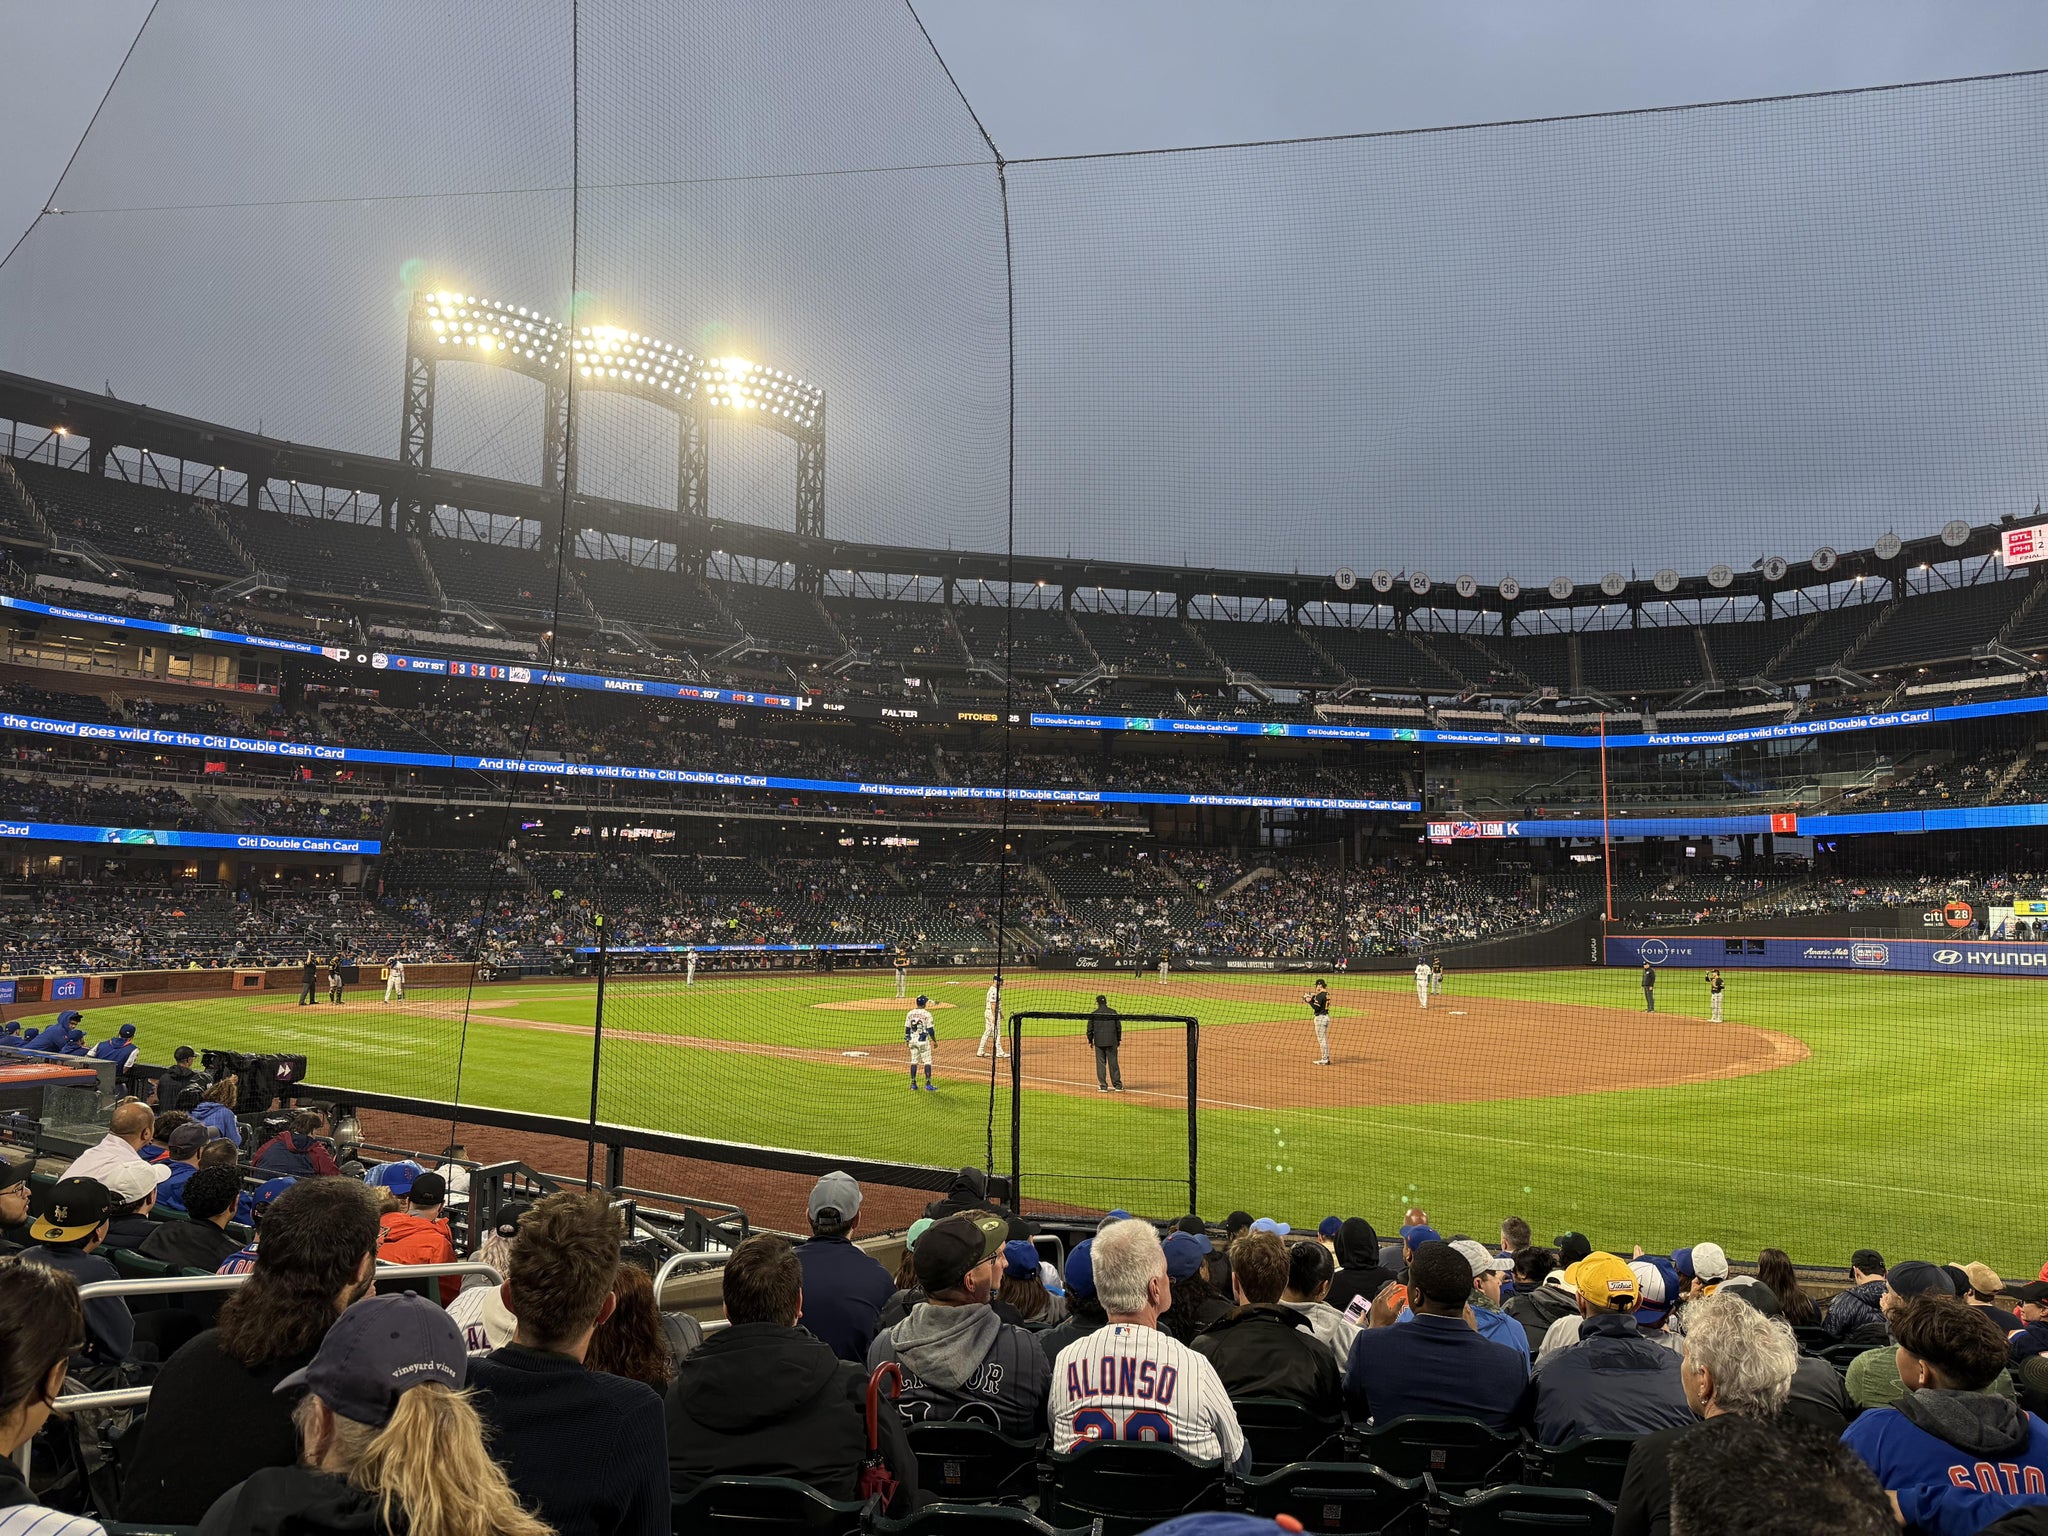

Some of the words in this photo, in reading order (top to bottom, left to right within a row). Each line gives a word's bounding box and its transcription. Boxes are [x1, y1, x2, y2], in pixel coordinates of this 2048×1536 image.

[2012, 545, 2031, 553] PHI
[1342, 574, 1350, 583] 18
[1378, 576, 1386, 586] 16
[1712, 572, 1726, 581] 37
[1414, 578, 1426, 588] 24
[1462, 582, 1470, 591] 17
[1607, 579, 1619, 589] 41
[1504, 584, 1515, 594] 36
[62, 610, 87, 618] Double
[605, 680, 643, 691] MARTE
[678, 688, 699, 697] AVG
[700, 690, 719, 699] .197
[882, 709, 917, 718] FALTER
[958, 713, 998, 721] PITCHES
[1692, 734, 1724, 742] crowd
[1751, 728, 1771, 737] wild
[1774, 726, 1787, 735] for
[1790, 725, 1807, 734] the
[1809, 722, 1826, 732] Citi
[1829, 719, 1867, 730] Double
[1870, 716, 1898, 725] Cash
[1901, 712, 1929, 722] Card
[3, 715, 28, 728] the
[31, 721, 75, 733] crowd
[79, 726, 115, 737] goes
[119, 729, 150, 740] wild
[153, 731, 174, 742] for
[177, 734, 200, 745] the
[204, 736, 226, 747] Citi
[230, 738, 276, 752] Double
[280, 741, 313, 755] Cash
[315, 746, 344, 758] Card
[479, 758, 503, 768] And
[506, 760, 526, 770] the
[528, 764, 564, 773] crowd
[566, 766, 593, 775] goes
[596, 767, 618, 776] wild
[621, 768, 636, 777] for
[638, 769, 656, 778] the
[658, 770, 676, 780] Citi
[678, 772, 714, 782] Double
[716, 774, 741, 784] Cash
[744, 776, 766, 786] Card
[860, 784, 877, 792] And
[879, 785, 893, 794] the
[895, 787, 923, 795] crowd
[925, 789, 948, 798] goes
[950, 788, 968, 796] wild
[970, 788, 984, 797] for
[986, 789, 1000, 797] the
[1002, 790, 1018, 798] Citi
[1020, 790, 1052, 800] Double
[1053, 791, 1076, 800] Cash
[1078, 792, 1100, 800] Card
[1189, 795, 1207, 804] And
[1274, 798, 1292, 806] wild
[1293, 798, 1305, 806] for
[1338, 800, 1367, 808] Double
[1369, 801, 1390, 809] Cash
[1392, 802, 1411, 810] Card
[1780, 817, 1787, 828] 1
[1430, 825, 1450, 836] LGM
[1483, 824, 1502, 835] LGM
[1508, 823, 1519, 835] K
[238, 838, 257, 846] Citi
[260, 838, 300, 848] Double
[303, 840, 330, 849] Cash
[333, 842, 358, 850] Card
[1923, 910, 1943, 922] citi
[1955, 911, 1968, 919] 28
[1076, 957, 1098, 968] Ford
[58, 983, 75, 996] citi
[392, 1361, 434, 1378] vineyard
[436, 1363, 457, 1378] vines
[1067, 1356, 1178, 1406] ALONSO
